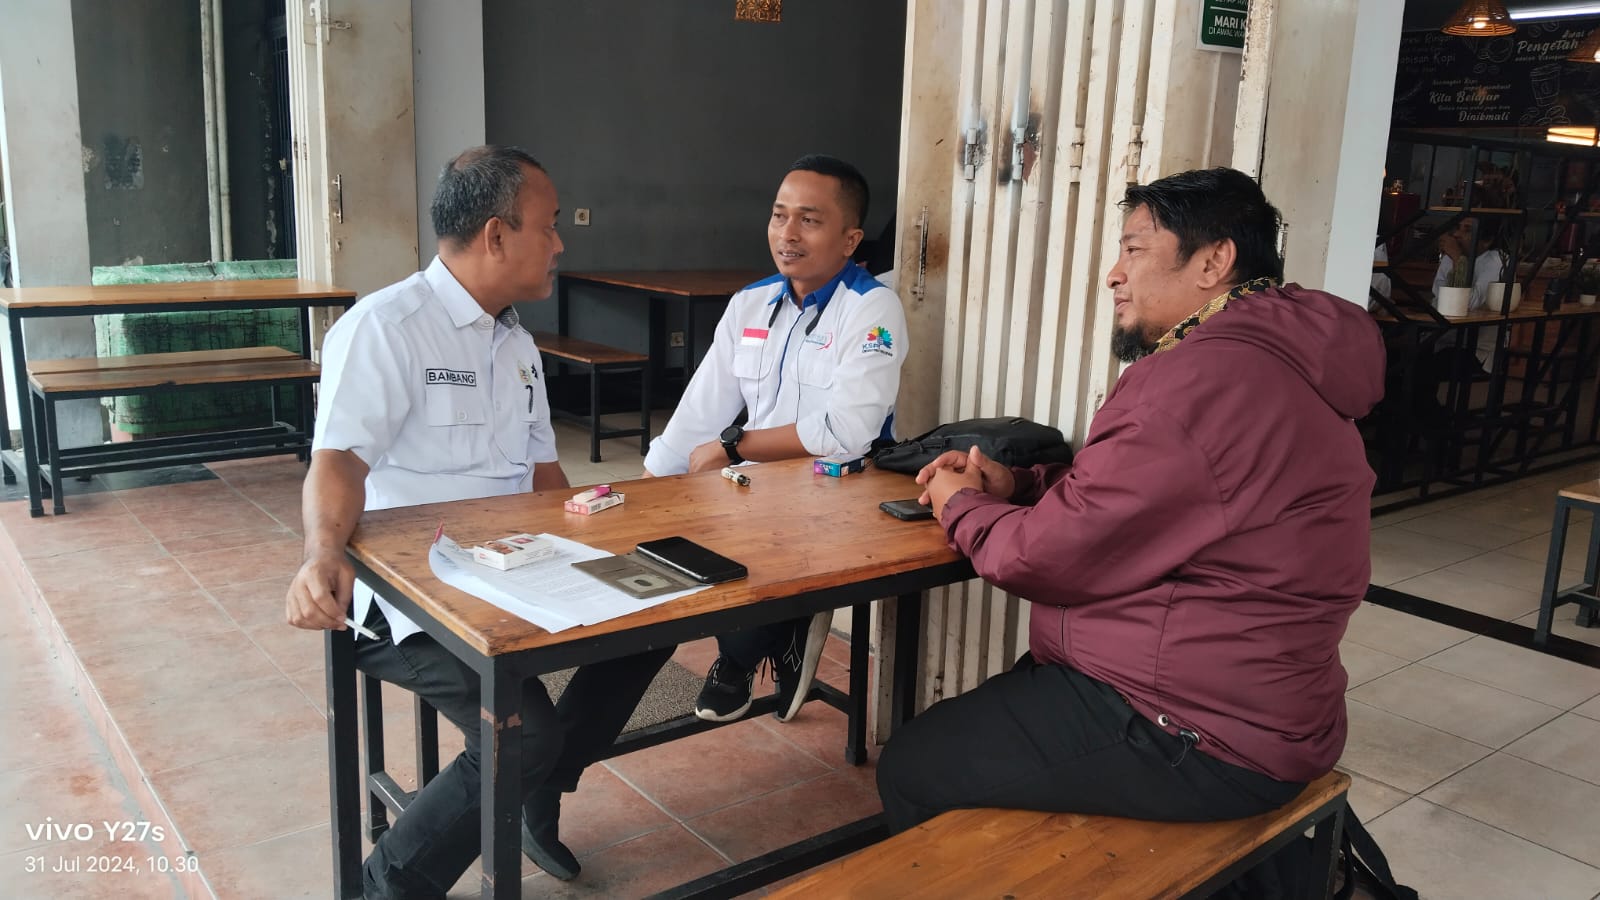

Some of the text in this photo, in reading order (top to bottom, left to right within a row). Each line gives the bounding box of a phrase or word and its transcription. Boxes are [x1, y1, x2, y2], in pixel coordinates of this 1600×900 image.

[1214, 15, 1239, 29] MARI
[1208, 26, 1216, 35] DI
[1517, 38, 1580, 56] Pengetah
[1433, 49, 1456, 66] Kopi
[1429, 90, 1501, 105] Kita Belajar
[428, 371, 475, 384] BAMBANG
